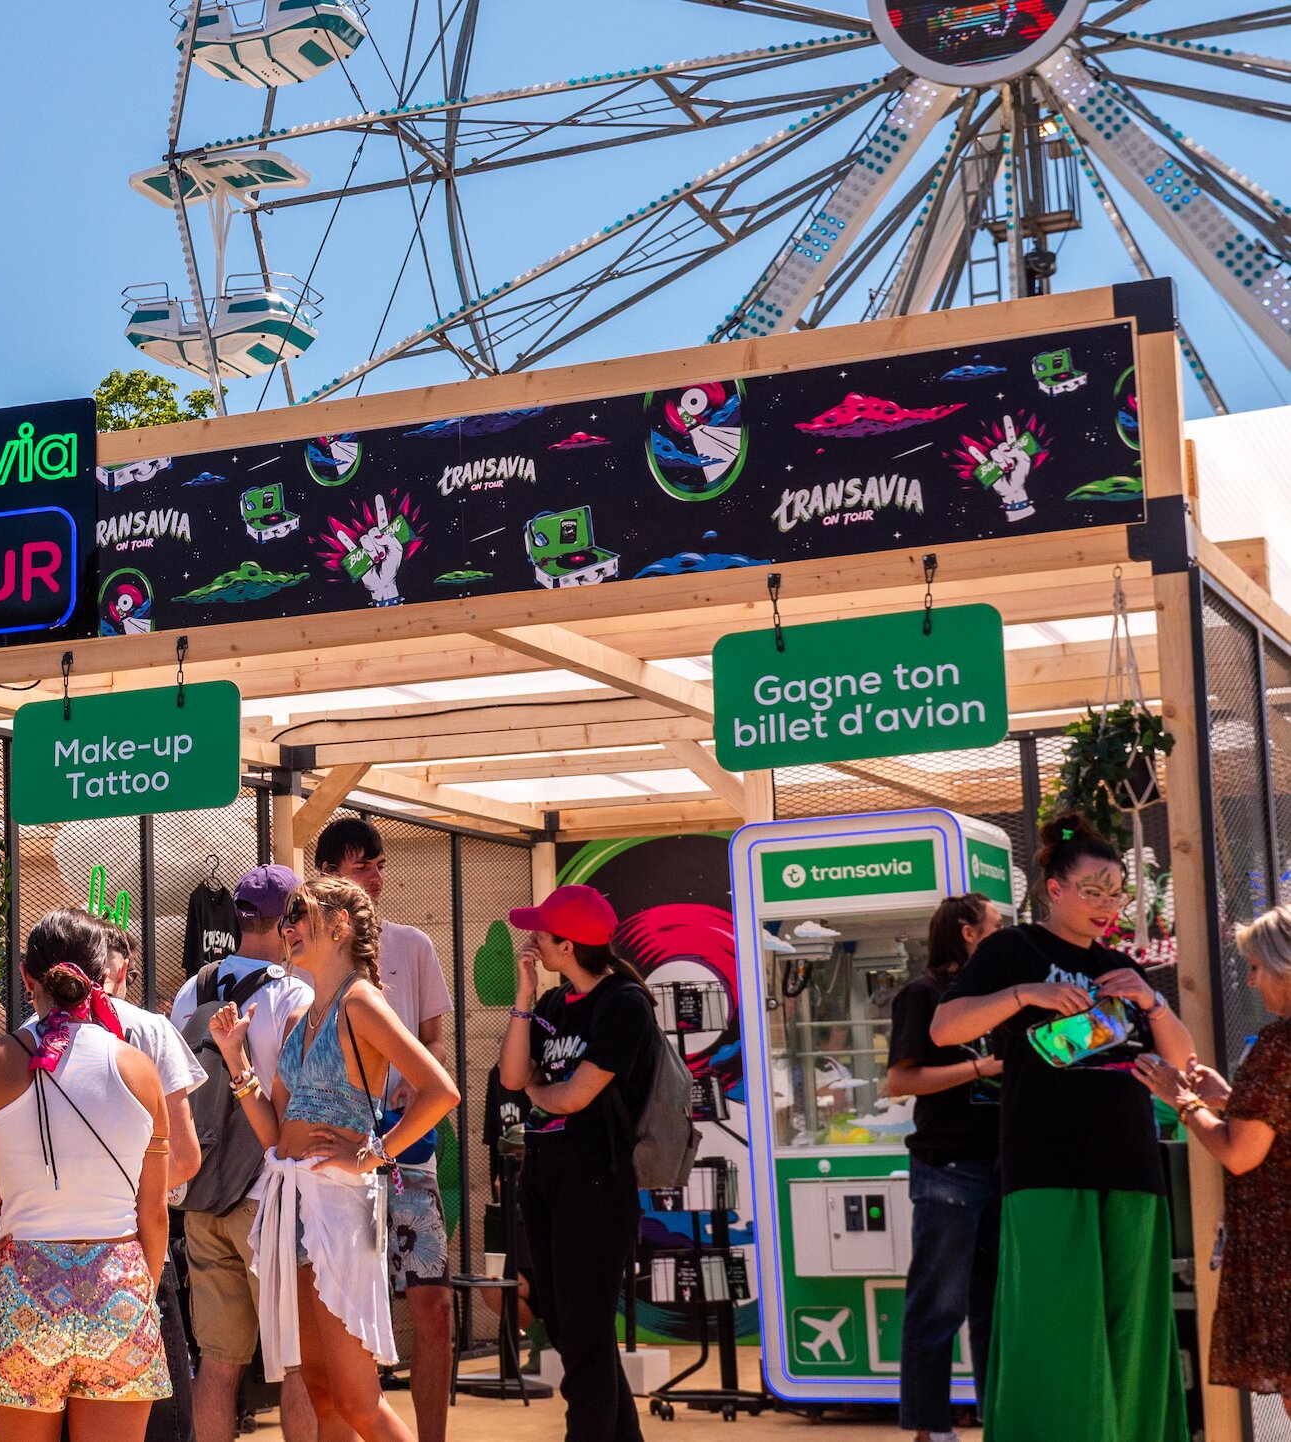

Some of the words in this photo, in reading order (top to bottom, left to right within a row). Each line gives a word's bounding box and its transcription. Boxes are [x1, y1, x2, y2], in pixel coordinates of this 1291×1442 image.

[470, 482, 482, 492] ON
[483, 480, 505, 491] TOUR
[95, 507, 192, 548] RANSAVIA
[822, 512, 841, 526] ON
[842, 509, 875, 525] TOUR
[115, 540, 129, 552] ON
[130, 538, 155, 551] TOUR
[753, 671, 883, 712] Gagne
[892, 662, 960, 691] ton
[733, 711, 829, 748] billet
[838, 697, 986, 737] d'avion
[54, 734, 193, 767] Make-up
[65, 770, 170, 800] Tattoo
[810, 858, 913, 881] transavia
